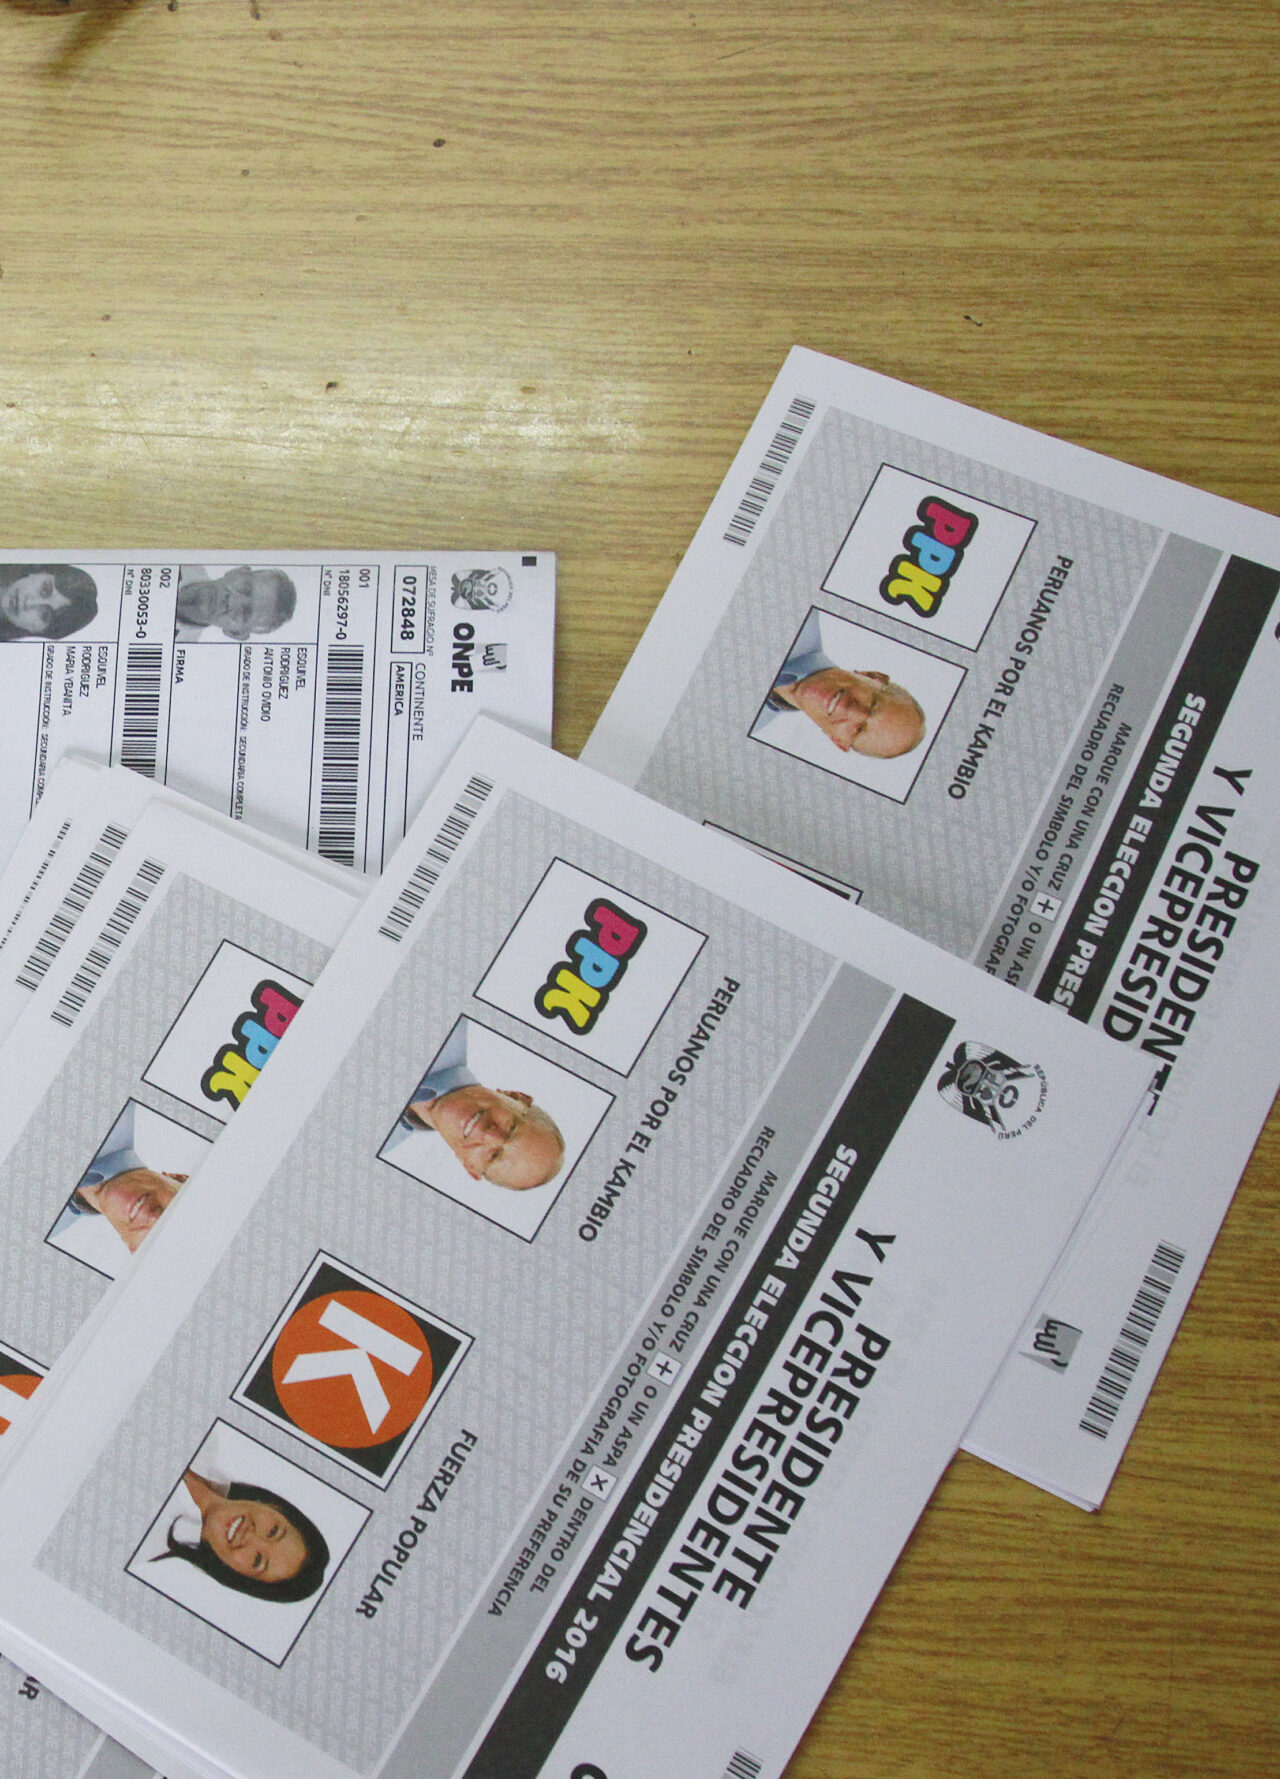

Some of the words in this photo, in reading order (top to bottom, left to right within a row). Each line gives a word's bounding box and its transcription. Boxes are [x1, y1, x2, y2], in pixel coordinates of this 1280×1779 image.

[159, 568, 172, 588] 002
[359, 568, 371, 588] 001
[879, 496, 979, 618] PPK
[125, 580, 133, 595] DNI
[135, 568, 152, 639] 80330053-0
[323, 580, 332, 596] DNI
[335, 569, 350, 640] 18056297-0
[400, 576, 417, 640] 072848
[428, 588, 436, 599] DE
[1015, 555, 1074, 655] PERUANOS
[45, 670, 53, 680] DE
[65, 646, 76, 675] MARIA
[79, 646, 92, 697] RODRIGUEZ
[96, 646, 108, 689] ESQUIVEL
[175, 649, 186, 684] FIRMA
[242, 668, 251, 681] DE
[243, 646, 252, 669] GRADO
[262, 647, 274, 689] ANTONIO
[278, 647, 291, 699] RODRIGUEZ
[295, 647, 307, 691] ESQUIVEL
[451, 623, 475, 693] ONPE
[994, 656, 1027, 696] POR
[260, 691, 272, 722] OVIDIO
[394, 665, 405, 716] AMERICA
[408, 662, 426, 741] CONTINENTE
[983, 698, 1007, 718] EL
[1081, 683, 1125, 761] RECUADRO
[38, 733, 48, 776] SECUNDARIA
[237, 736, 247, 780] SECUNDARIA
[948, 723, 995, 800] KAMBIO
[1096, 722, 1132, 785] MARQUE
[1139, 693, 1206, 808] SEGUNDA
[1065, 764, 1088, 790] DEL
[1213, 766, 1253, 796] Y
[235, 781, 244, 820] COMPLETA
[1081, 787, 1103, 818] CON
[1035, 794, 1074, 861] SIMBOLO
[1065, 819, 1090, 849] UNA
[1021, 865, 1043, 892] Y/O
[1048, 853, 1073, 891] CRUZ
[1084, 814, 1153, 936] ELECCION
[980, 891, 1030, 976] FOTOGRAF
[1028, 922, 1042, 934] O
[1103, 805, 1235, 1042] VICEPRESID
[534, 898, 648, 1036] PPK
[1016, 937, 1036, 960] UN
[1140, 851, 1260, 1078] PRESIDEN
[200, 979, 304, 1111] PPK
[668, 976, 741, 1086] PERUANOS
[641, 1086, 678, 1130] POR
[1022, 1115, 1037, 1130] DEL
[625, 1131, 652, 1154] EL
[721, 1126, 775, 1210] RECUADRO
[579, 1158, 636, 1242] KAMBIO
[733, 1170, 778, 1239] MARQUE
[775, 1144, 857, 1269] SEGUNDA
[701, 1212, 727, 1241] DEL
[855, 1228, 896, 1263] Y
[714, 1240, 739, 1274] CON
[661, 1245, 708, 1317] SIMBOLO
[693, 1275, 721, 1307] UNA
[642, 1322, 667, 1351] Y/O
[669, 1311, 699, 1353] CRUZ
[700, 1274, 787, 1407] ELECCION
[282, 1299, 423, 1434] K
[580, 1353, 647, 1455] FOTOGRAFIA
[627, 1401, 649, 1426] UN
[643, 1385, 657, 1399] O
[602, 1426, 633, 1466] ASPA
[712, 1323, 891, 1610] PRESIDENTE
[416, 1429, 478, 1512] FUERZA
[566, 1458, 587, 1484] DE
[625, 1270, 873, 1673] VICEPRESIDENTES
[553, 1483, 572, 1508] SU
[587, 1407, 712, 1600] PRESIDENCIAL
[550, 1496, 594, 1562] DENTRO
[355, 1515, 428, 1619] POPULAR
[488, 1509, 558, 1616] PREFERENCIA
[530, 1563, 556, 1593] DEL
[546, 1608, 598, 1684] 2016
